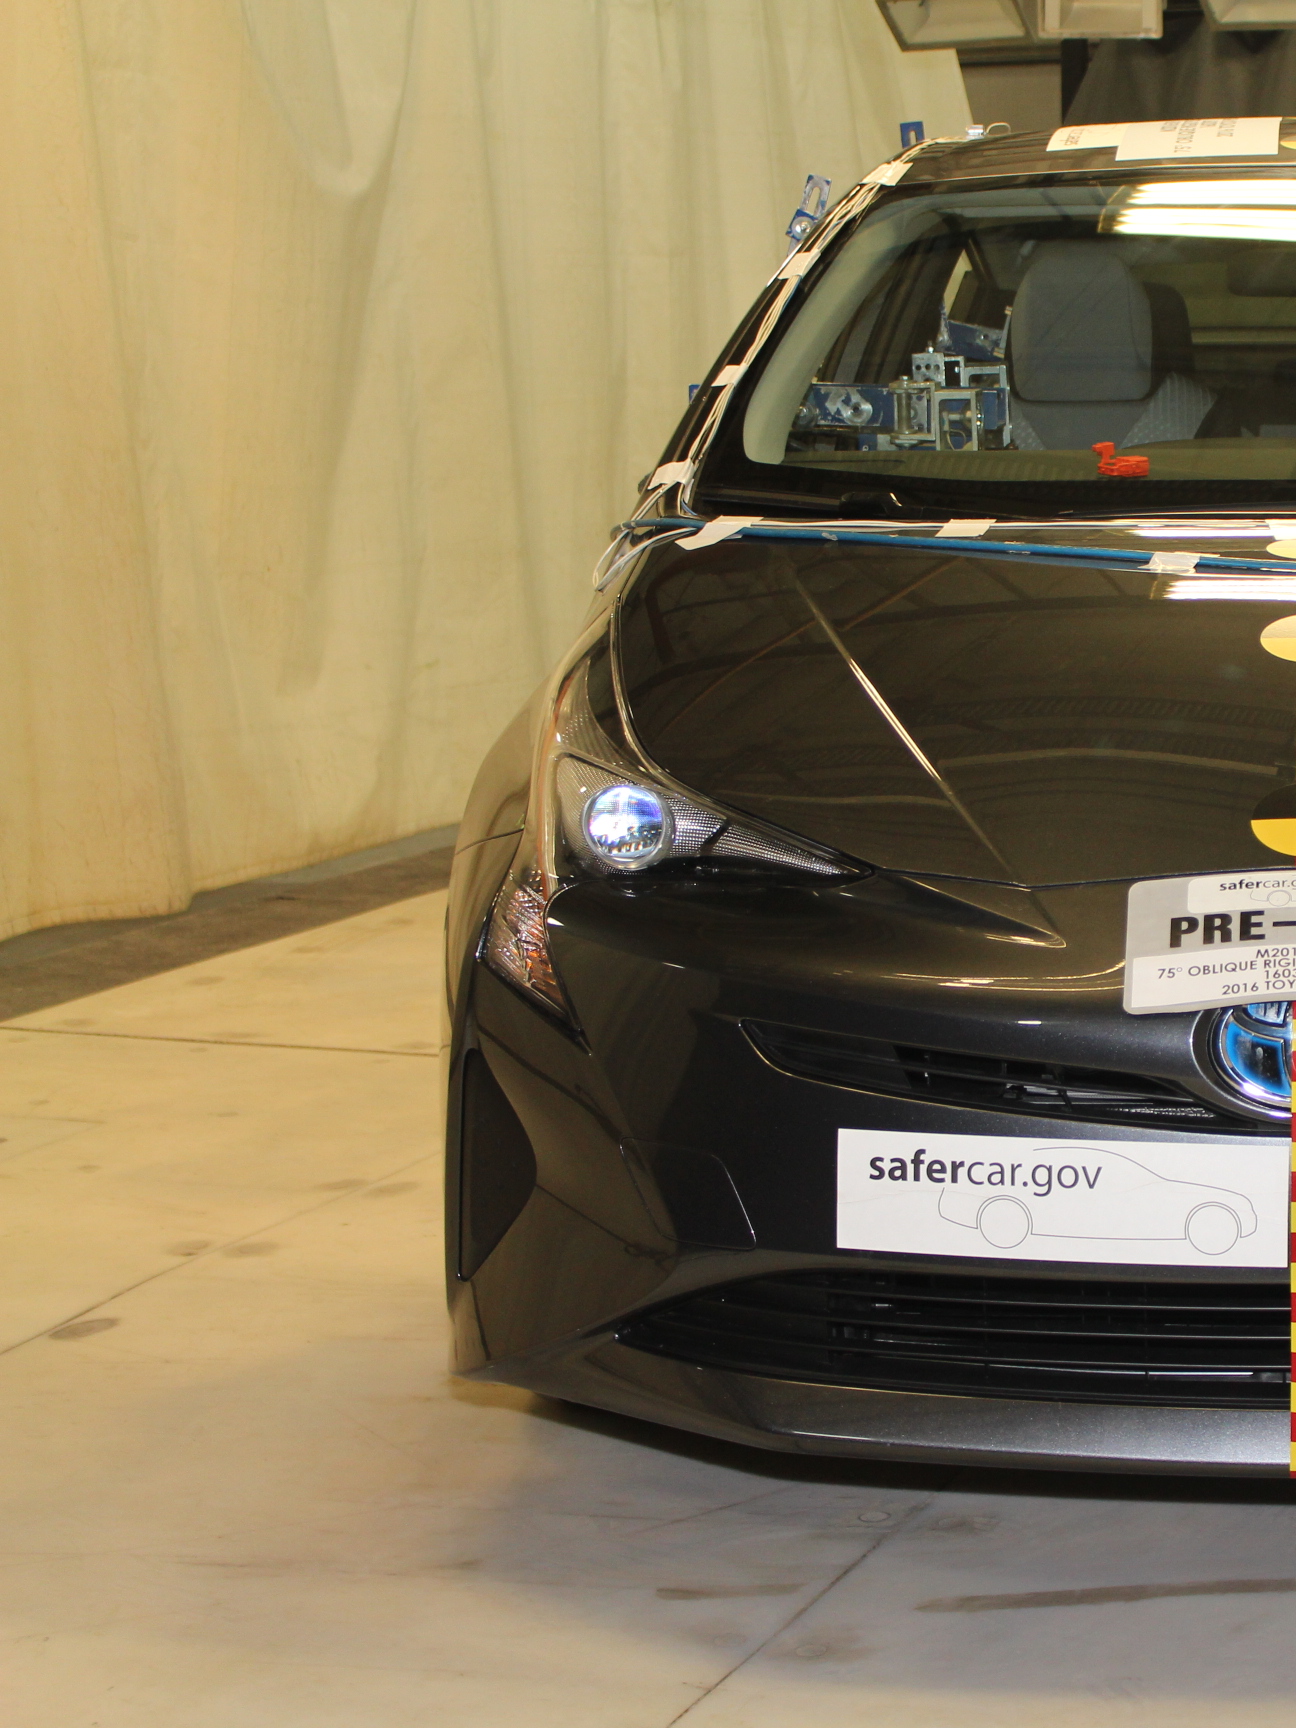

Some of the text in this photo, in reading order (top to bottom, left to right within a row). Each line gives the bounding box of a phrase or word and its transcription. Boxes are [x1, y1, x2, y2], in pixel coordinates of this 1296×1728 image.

[1157, 965, 1183, 979] 75°
[1189, 959, 1257, 976] OBLIQUE
[1222, 981, 1259, 995] 2016
[869, 1148, 1102, 1196] safercar.gov
